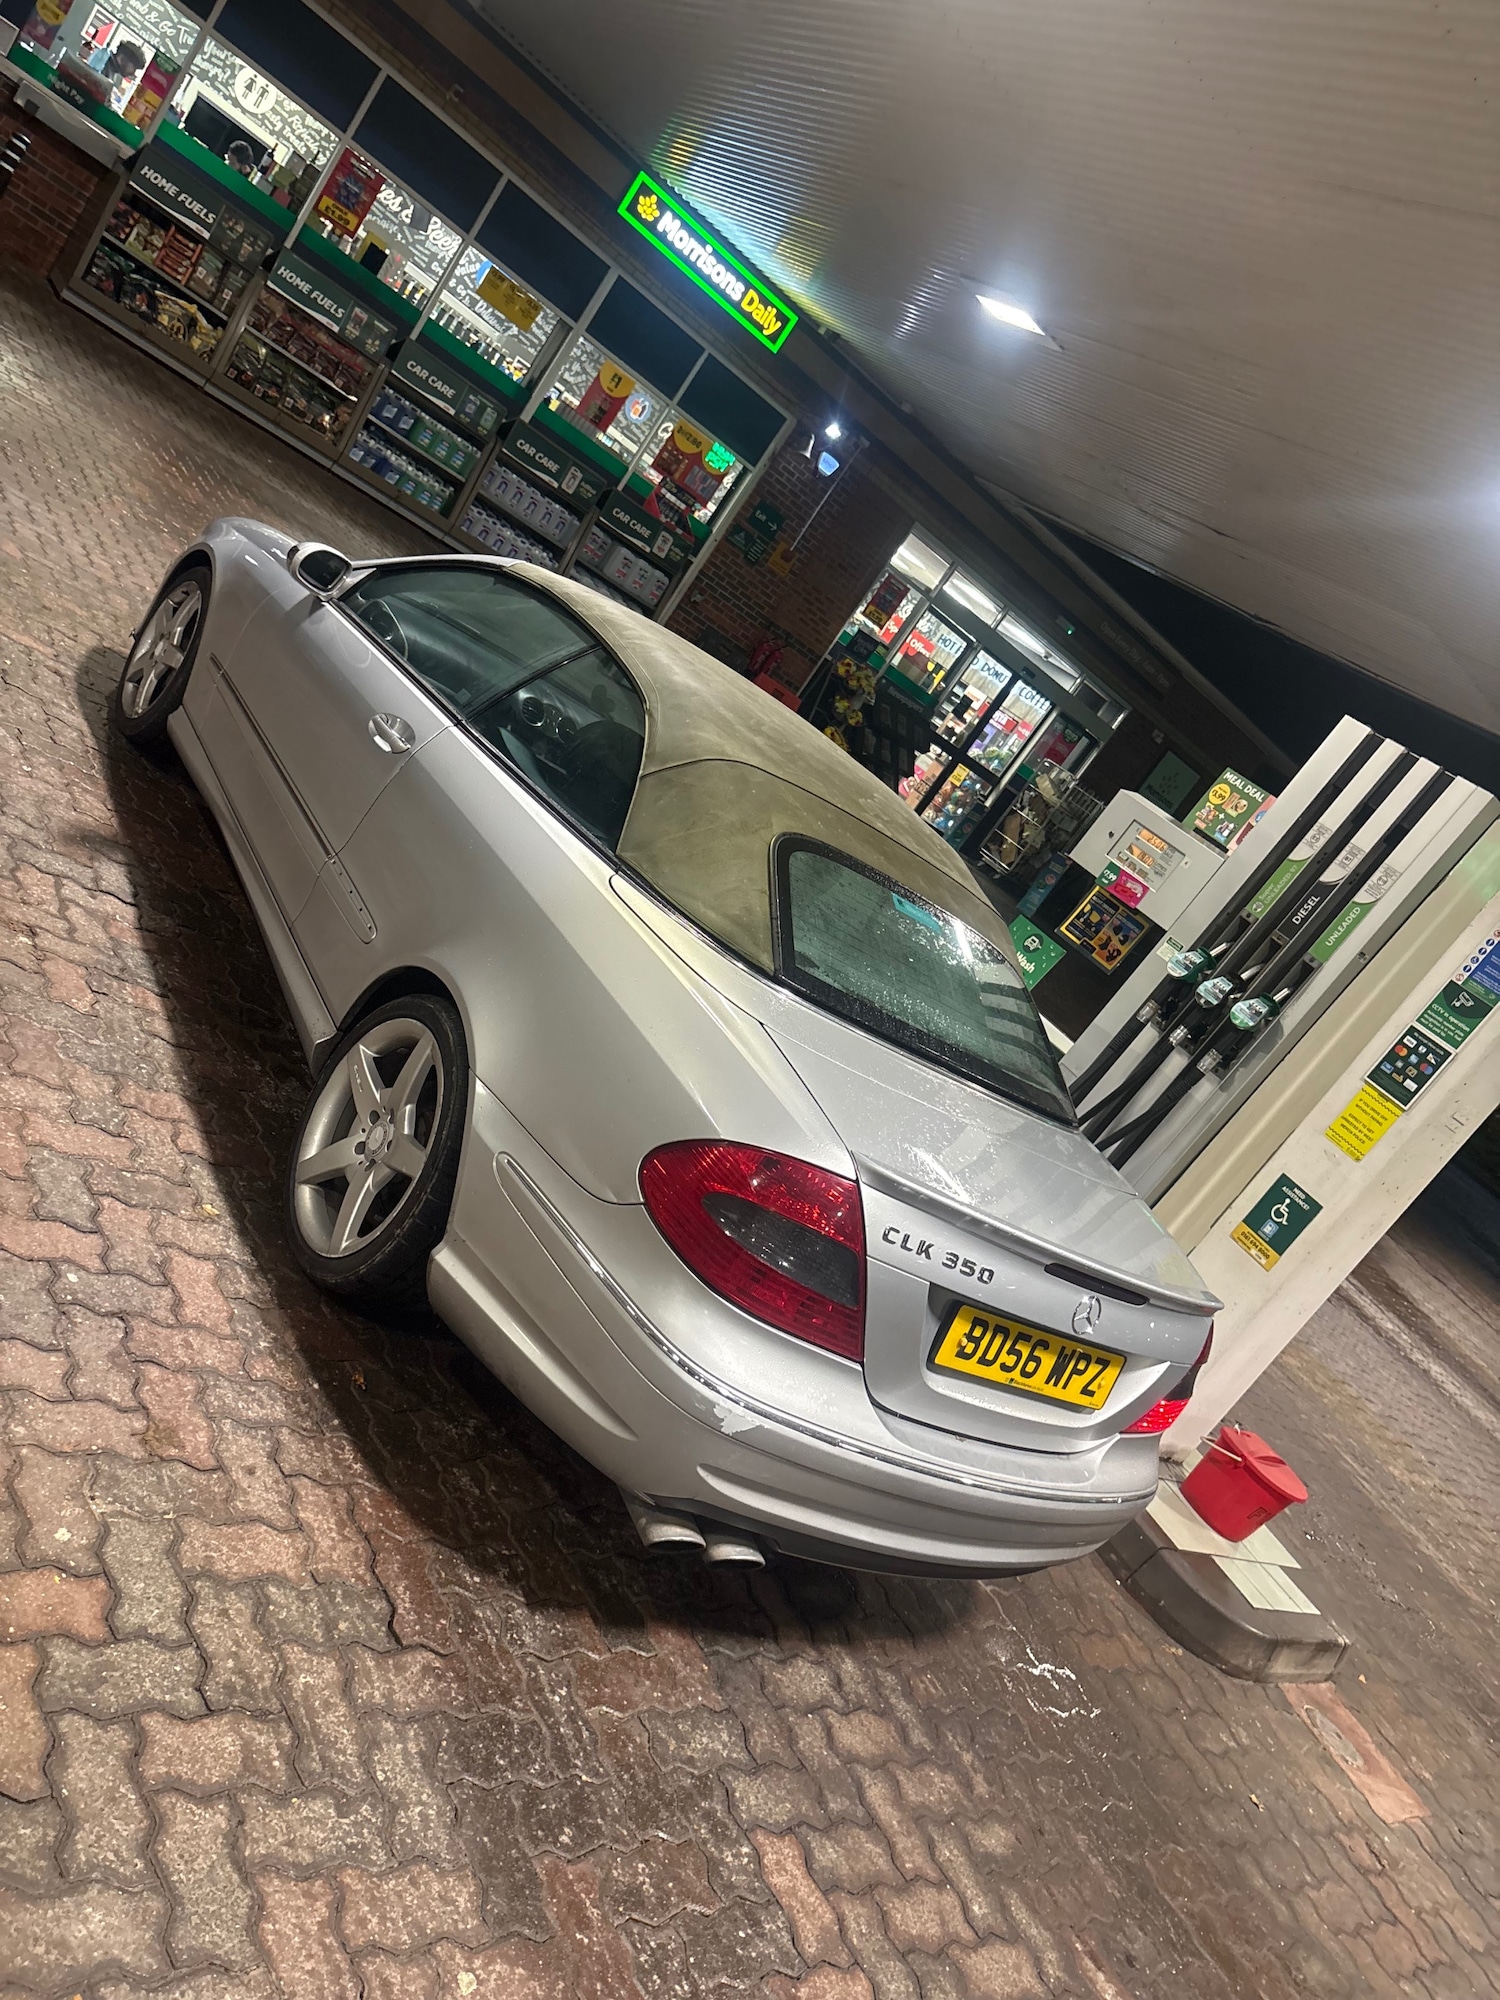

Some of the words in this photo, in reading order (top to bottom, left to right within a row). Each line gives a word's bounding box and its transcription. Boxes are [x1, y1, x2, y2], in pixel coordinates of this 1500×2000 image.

[157, 19, 177, 37] Go
[140, 165, 178, 196] HOME
[177, 192, 215, 223] FUELS
[656, 211, 745, 301] Morrisons
[741, 289, 781, 335] Daily
[277, 266, 311, 294] HOME
[311, 291, 344, 318] FUELS
[405, 360, 431, 381] CAR
[428, 376, 455, 398] CARE
[515, 439, 538, 457] CAR
[535, 452, 559, 473] CARE
[612, 507, 632, 524] CAR
[629, 520, 651, 538] CARE
[754, 510, 766, 521] Exit
[909, 638, 930, 657] Offers
[937, 634, 956, 650] HOT
[1211, 788, 1226, 802] £3.99
[1223, 771, 1244, 789] MEAL
[1244, 784, 1264, 802] DEAL
[1103, 868, 1117, 882] £7.99
[1264, 873, 1291, 904] UNLEADED
[1259, 883, 1275, 900] Super
[1292, 894, 1319, 923] DIESEL
[1326, 907, 1360, 945] UNLEADED
[1431, 1003, 1444, 1014] CCTV
[1448, 1015, 1469, 1032] operation
[1355, 1103, 1370, 1116] WITHOUT
[1369, 1106, 1380, 1116] DRIVE
[1379, 1113, 1388, 1121] OFF
[1340, 1123, 1352, 1134] MERCIA
[1352, 1133, 1365, 1144] POLICE
[1341, 1115, 1358, 1130] ARRESTED
[1362, 1132, 1373, 1142] WEST
[1348, 1113, 1361, 1124] EXPECT
[1365, 1126, 1374, 1135] GET
[1282, 1186, 1309, 1210] ASSISTANCE?
[1293, 1187, 1305, 1199] NEED
[882, 1226, 935, 1260] CLK
[941, 1252, 995, 1284] 350
[1240, 1231, 1250, 1241] 0161
[1249, 1239, 1259, 1249] 694
[1257, 1246, 1270, 1259] 8000
[955, 1316, 1050, 1379] BD56
[1044, 1346, 1111, 1398] WPZ
